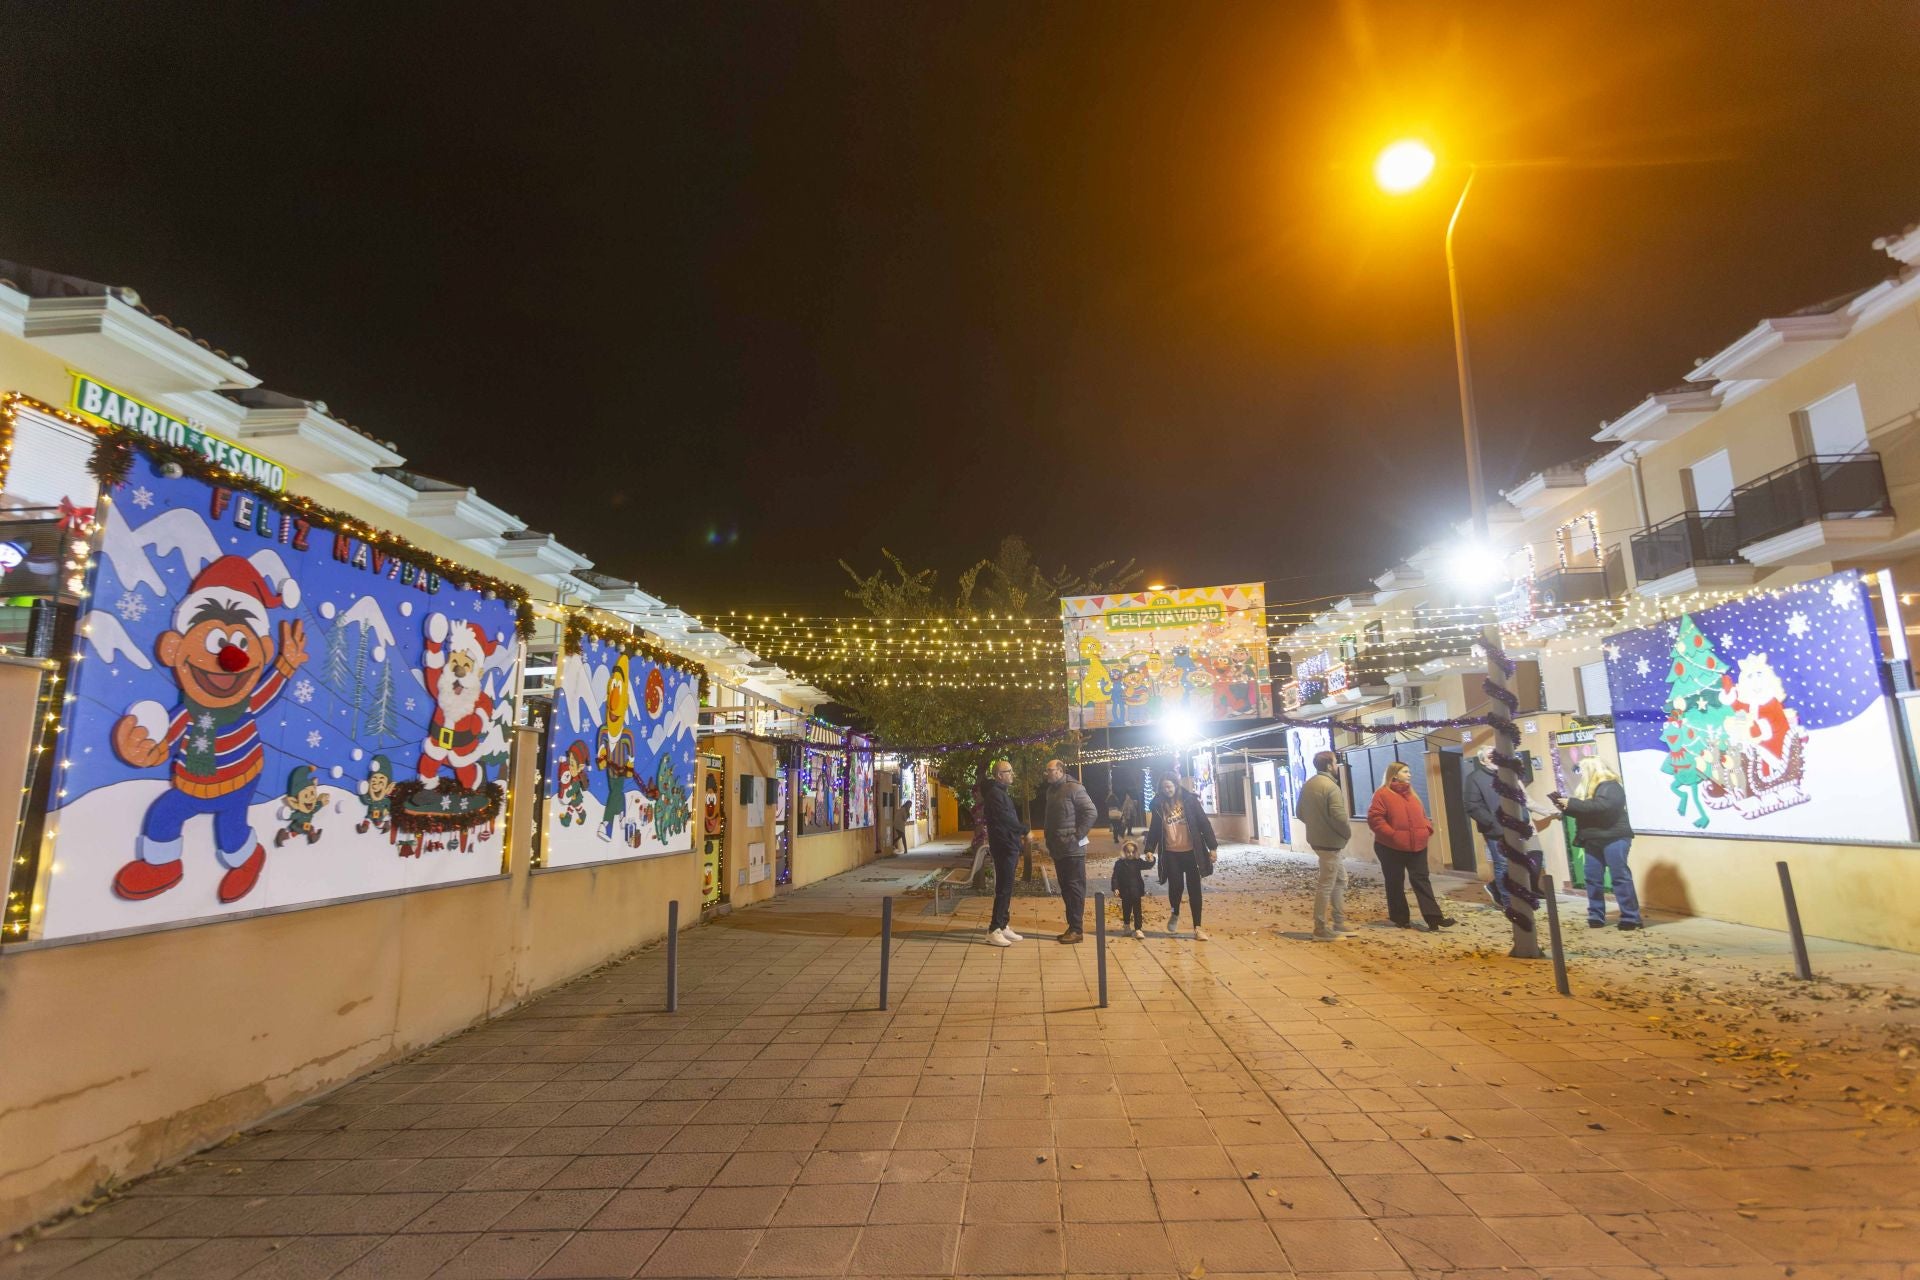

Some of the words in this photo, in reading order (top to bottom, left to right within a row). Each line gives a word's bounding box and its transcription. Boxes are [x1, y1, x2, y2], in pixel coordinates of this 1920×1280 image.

[82, 380, 185, 447] BARRIO
[211, 487, 311, 551] FELIZ
[1111, 611, 1152, 627] FELIZ
[1154, 606, 1219, 624] NAVIDAD
